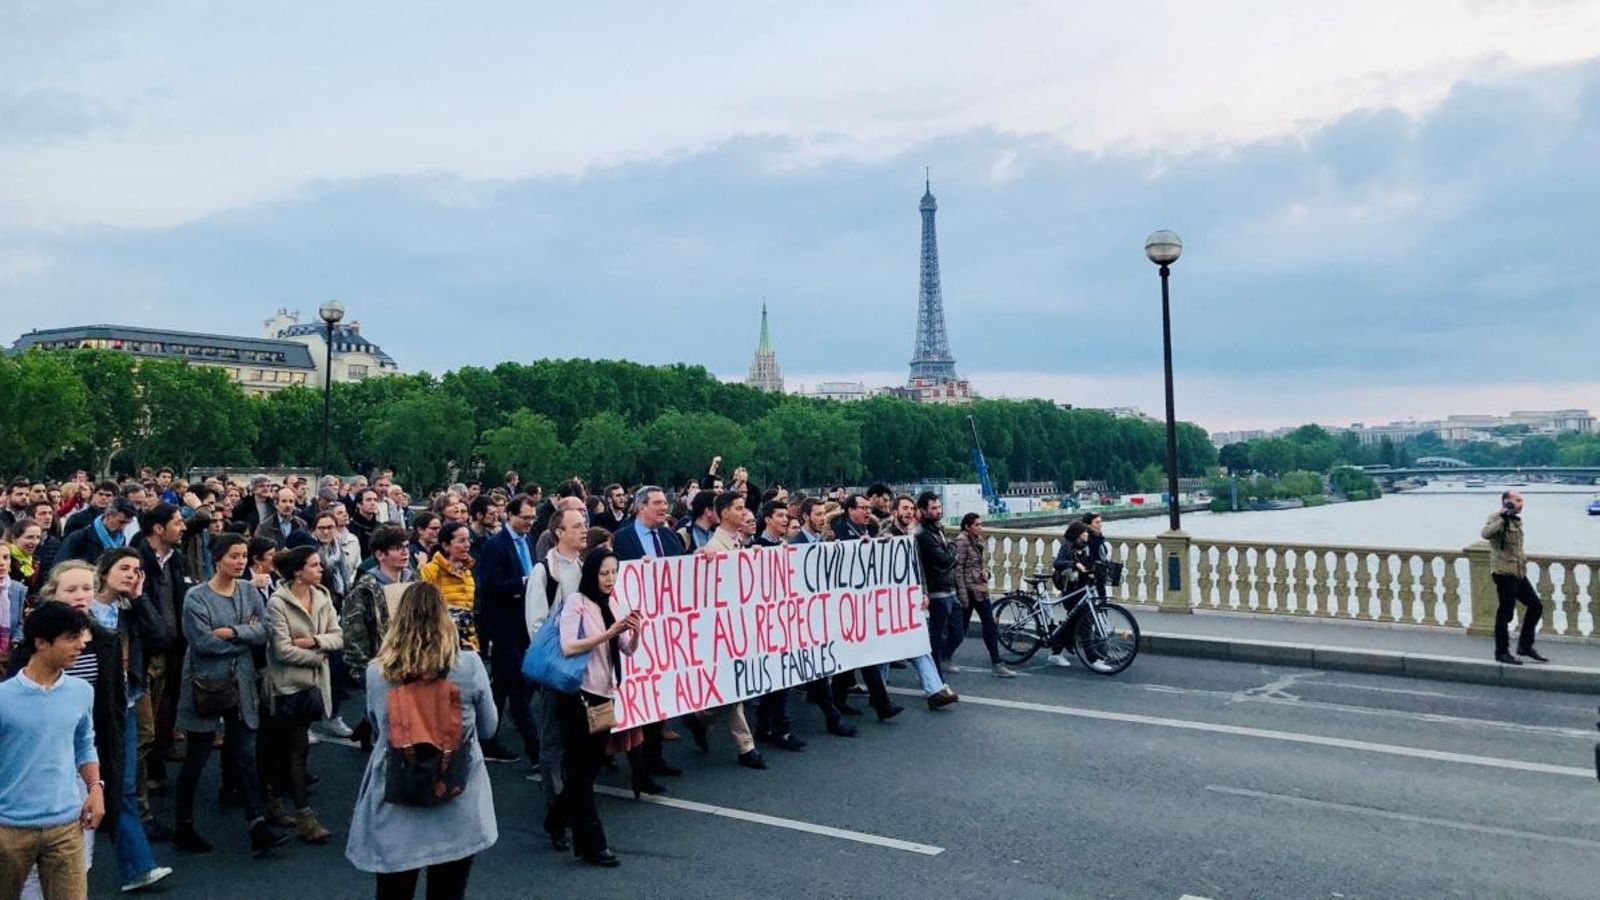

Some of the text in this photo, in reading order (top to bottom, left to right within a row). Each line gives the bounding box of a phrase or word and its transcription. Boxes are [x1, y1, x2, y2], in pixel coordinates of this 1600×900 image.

[737, 547, 798, 605] D'UNE
[803, 538, 921, 593] CIVILISATION
[623, 586, 922, 676] SURE AU RESPECT QU'ELLE
[612, 641, 843, 729] ORTE AUX PLUS FAIBLES.
